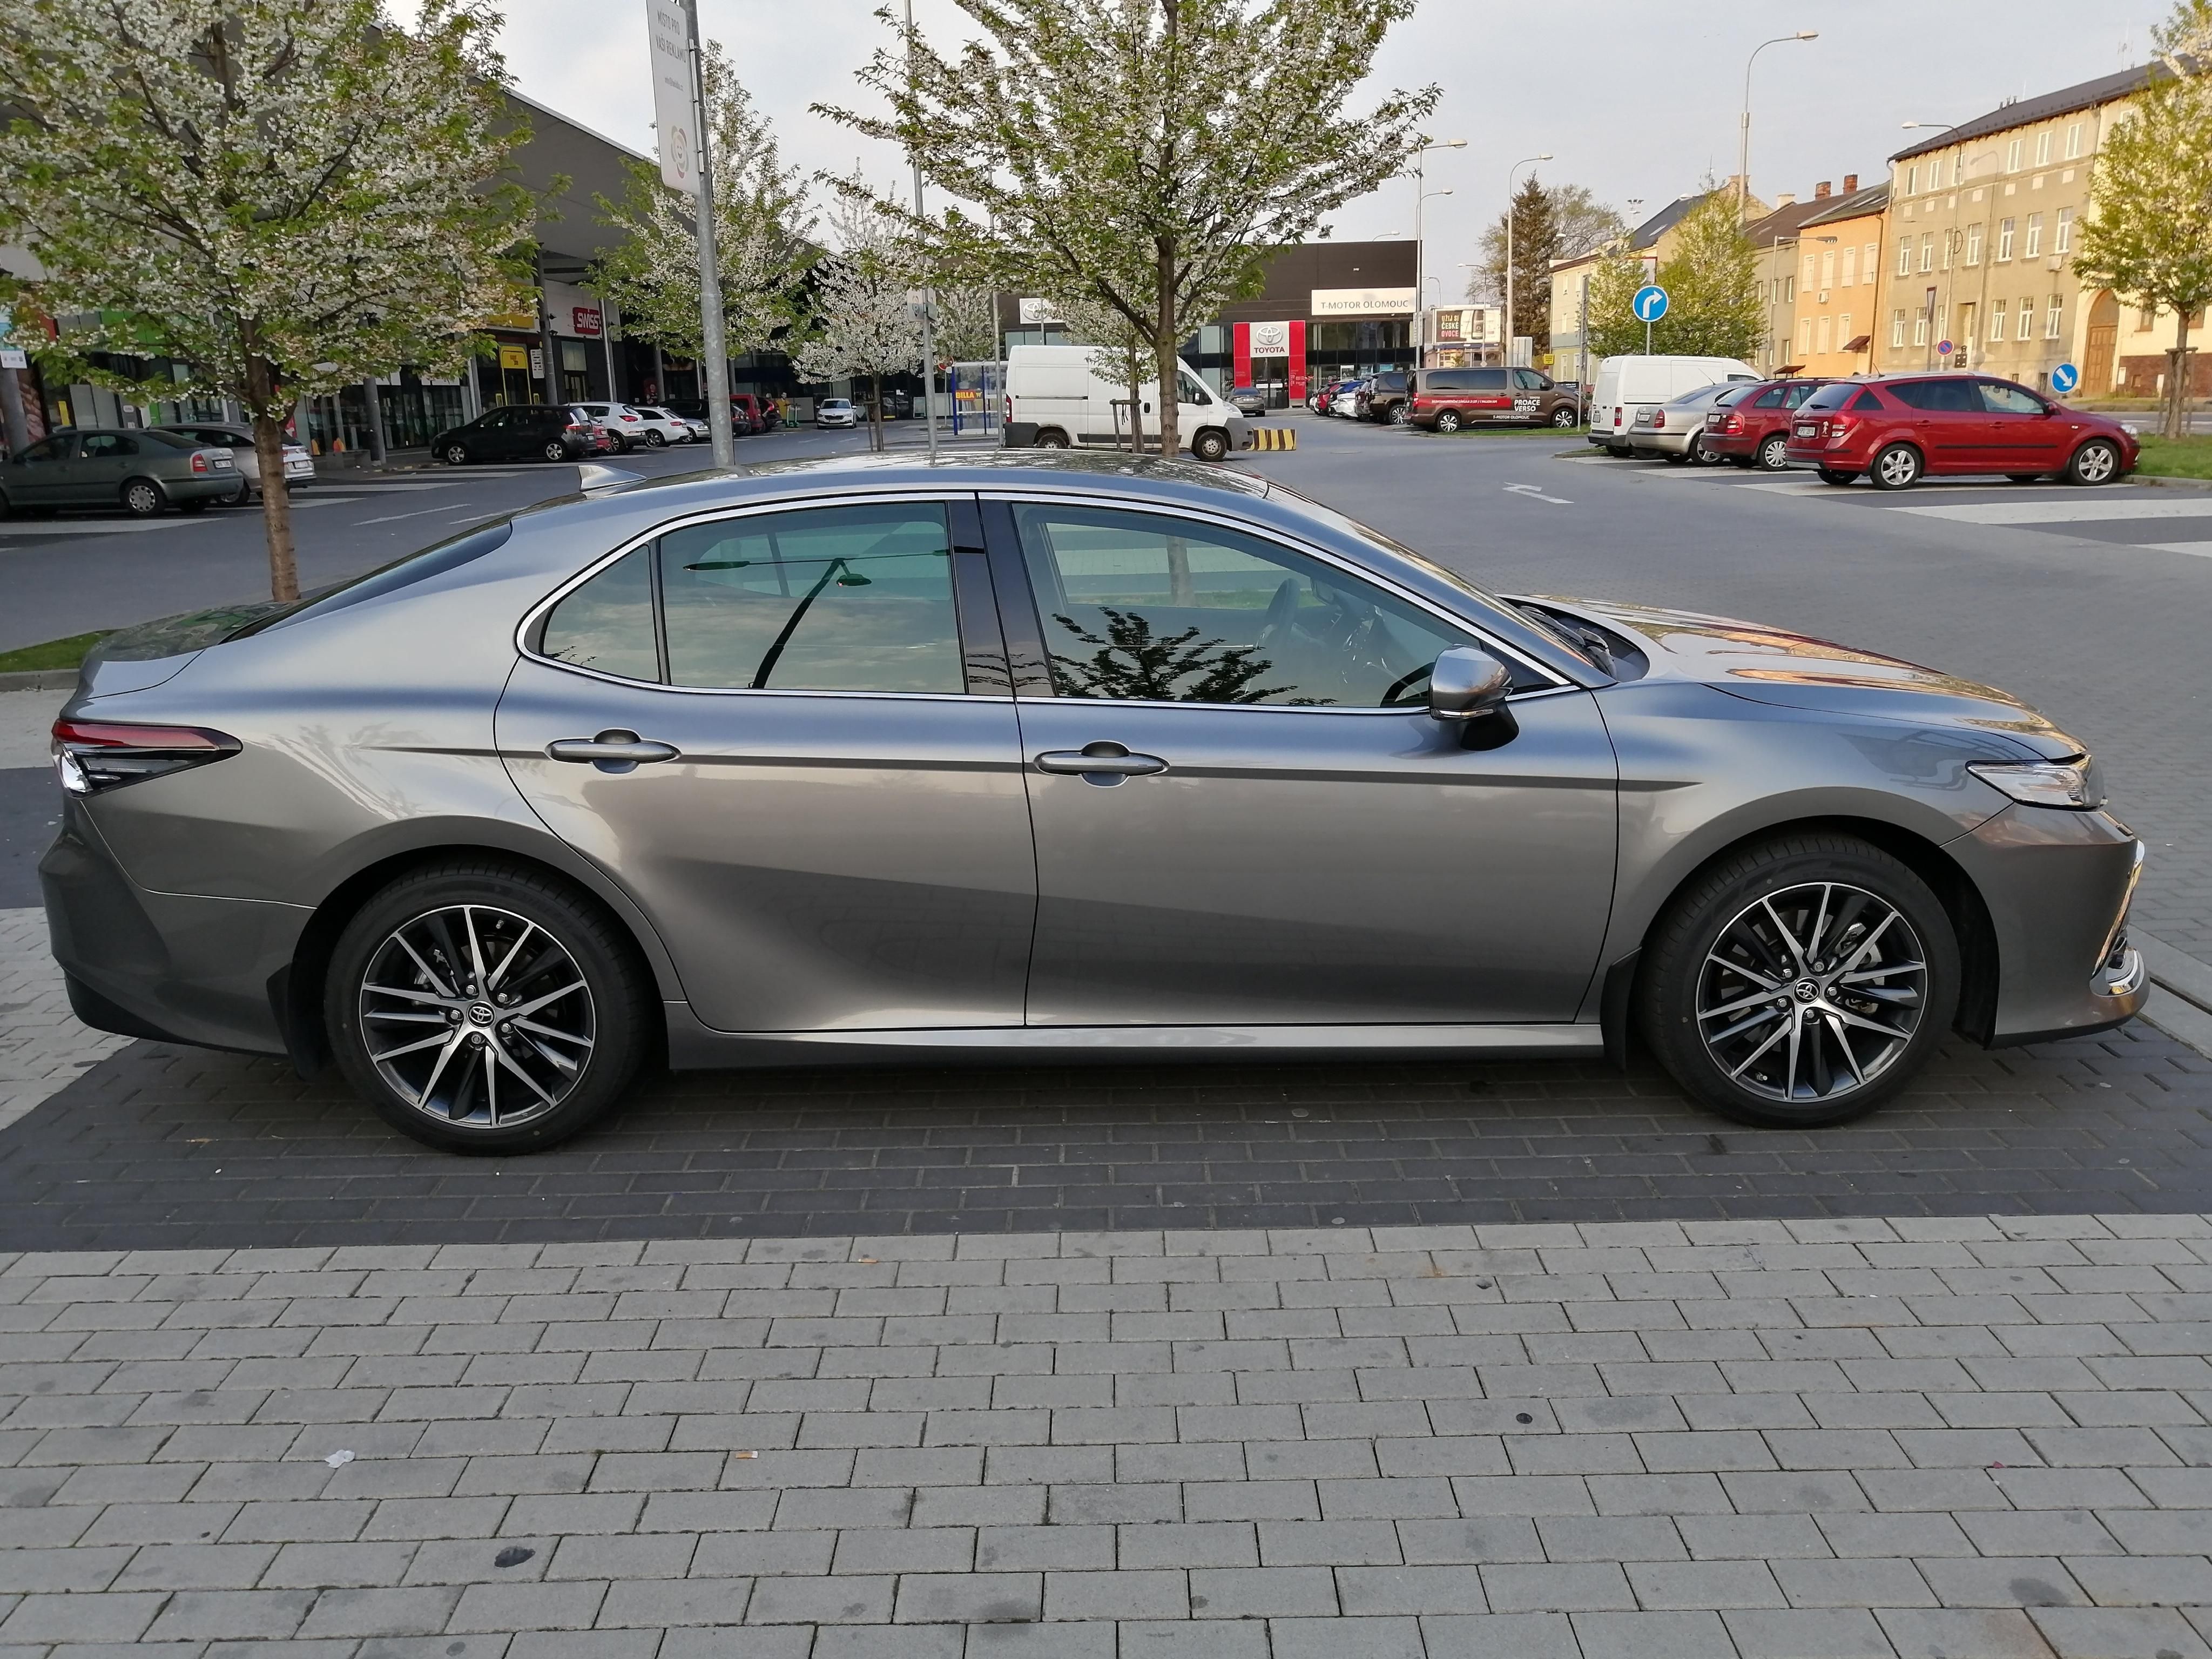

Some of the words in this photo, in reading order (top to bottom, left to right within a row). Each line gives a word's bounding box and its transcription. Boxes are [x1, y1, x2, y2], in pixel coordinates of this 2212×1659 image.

[657, 9, 671, 30] MÍSTO
[671, 18, 680, 35] PRO
[656, 33, 666, 52] VAŠI
[666, 40, 686, 63] REKLAMU
[1363, 300, 1408, 308] OLOMOUC
[1441, 321, 1459, 329] ČESKÉ
